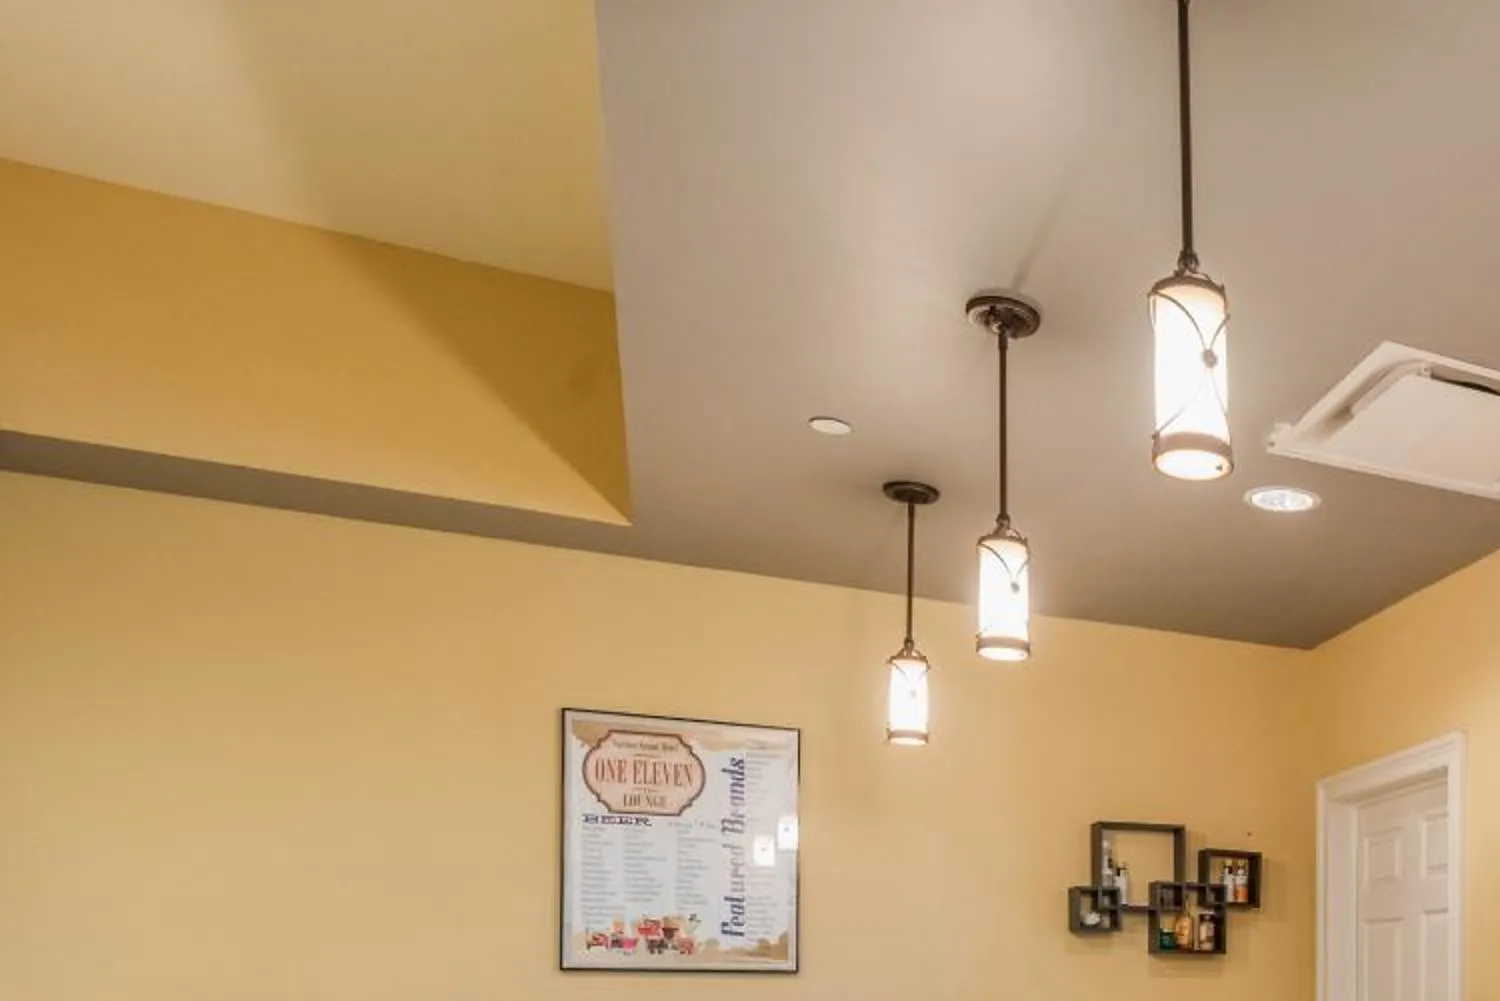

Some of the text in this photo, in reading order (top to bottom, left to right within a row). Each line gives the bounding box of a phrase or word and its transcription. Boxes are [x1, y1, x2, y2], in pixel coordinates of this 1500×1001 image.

[594, 758, 694, 787] ONE ELEVEN
[720, 757, 746, 938] Featured Brands
